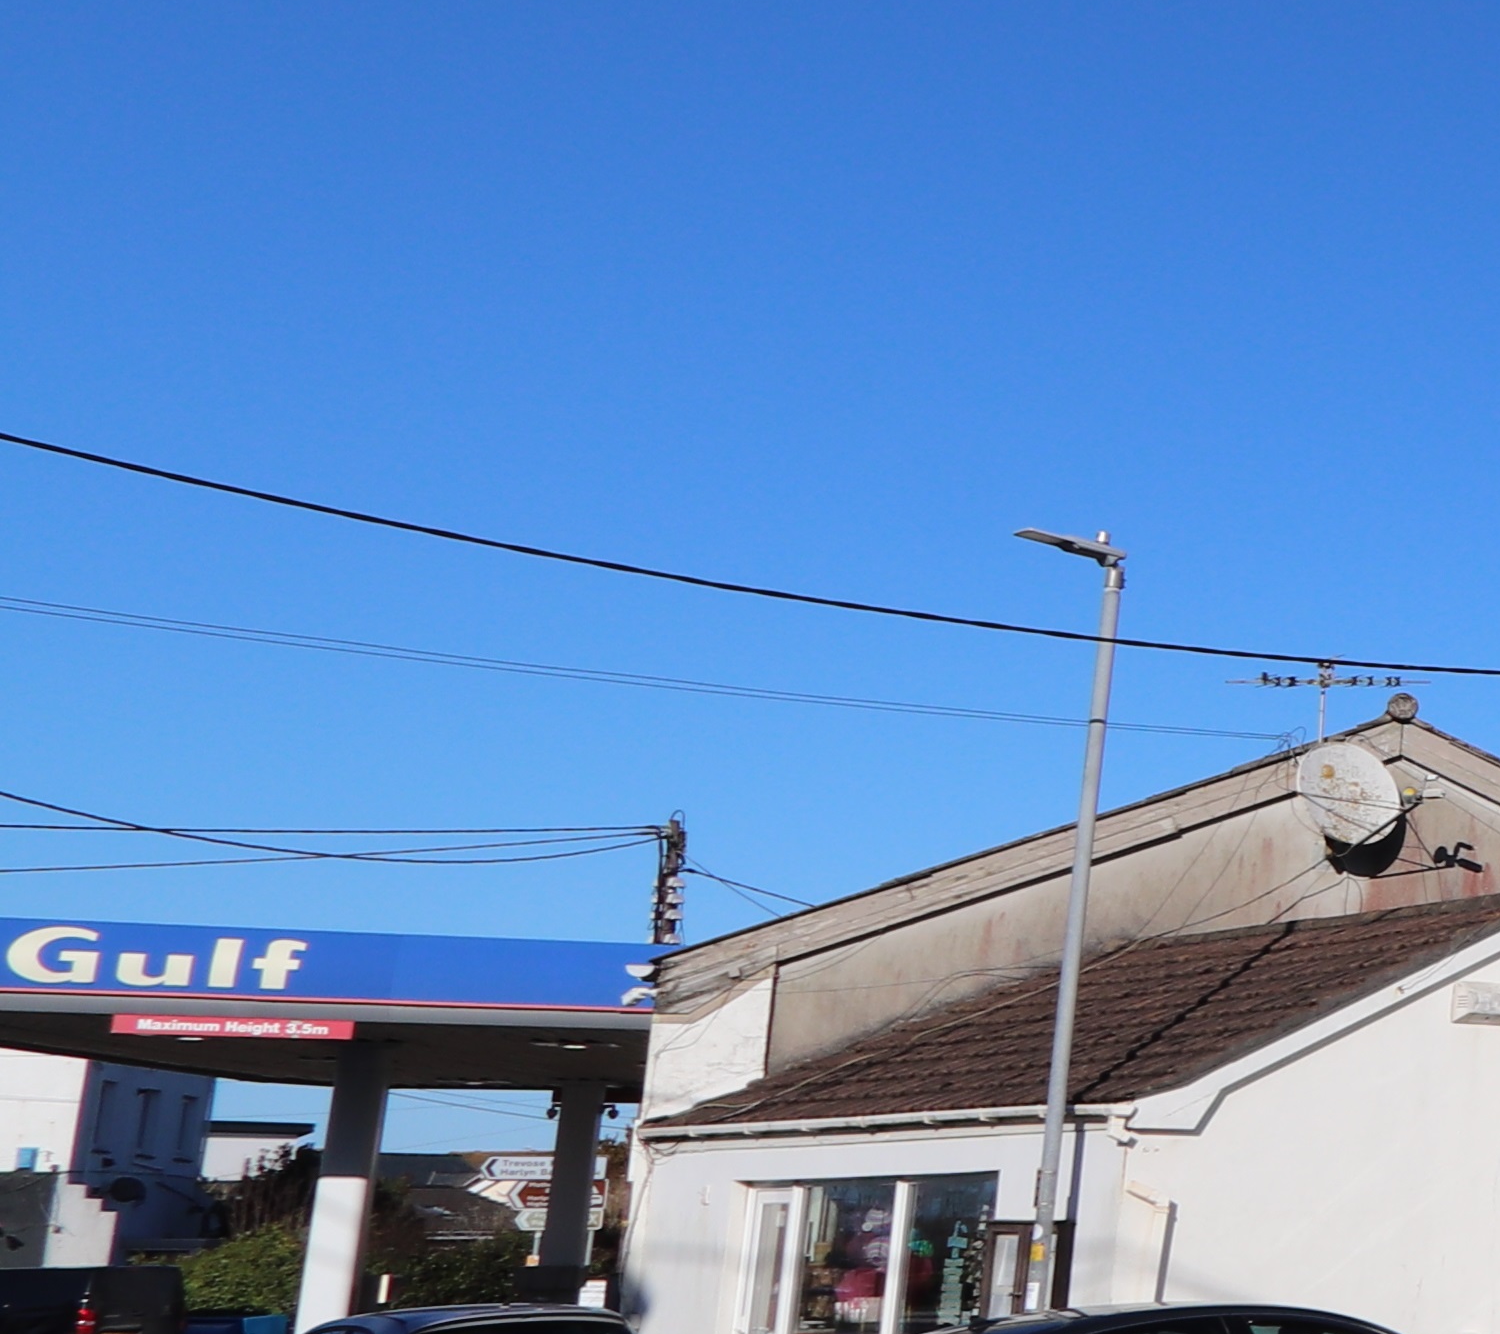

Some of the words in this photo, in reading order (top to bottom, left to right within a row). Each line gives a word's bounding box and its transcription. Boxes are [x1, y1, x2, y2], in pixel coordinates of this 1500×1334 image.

[7, 926, 308, 990] Gulf
[136, 1019, 220, 1033] Maximum
[224, 1020, 281, 1036] Height
[285, 1022, 330, 1036] 3.5m
[503, 1159, 546, 1167] Trevose
